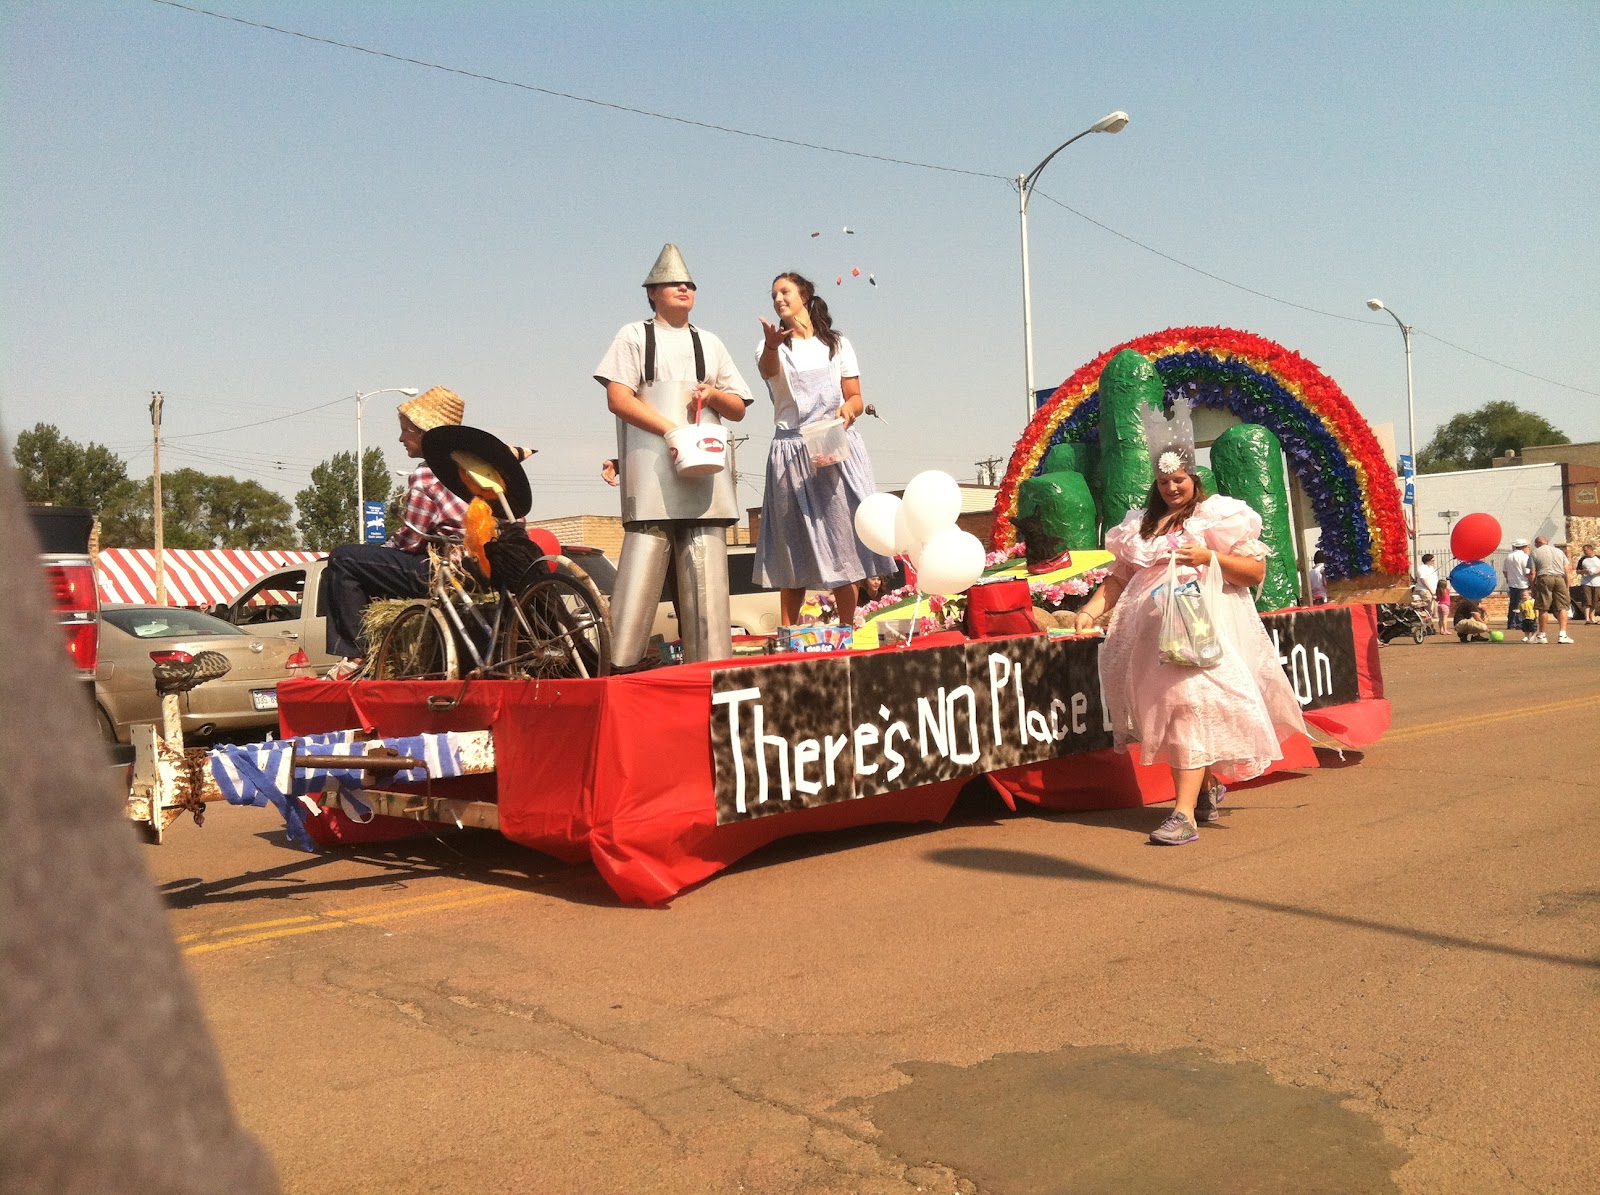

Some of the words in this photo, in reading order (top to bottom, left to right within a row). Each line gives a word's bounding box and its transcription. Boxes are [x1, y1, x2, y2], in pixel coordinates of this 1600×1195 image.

[712, 687, 911, 813] There's
[917, 685, 981, 765] NO
[988, 652, 1088, 746] Place
